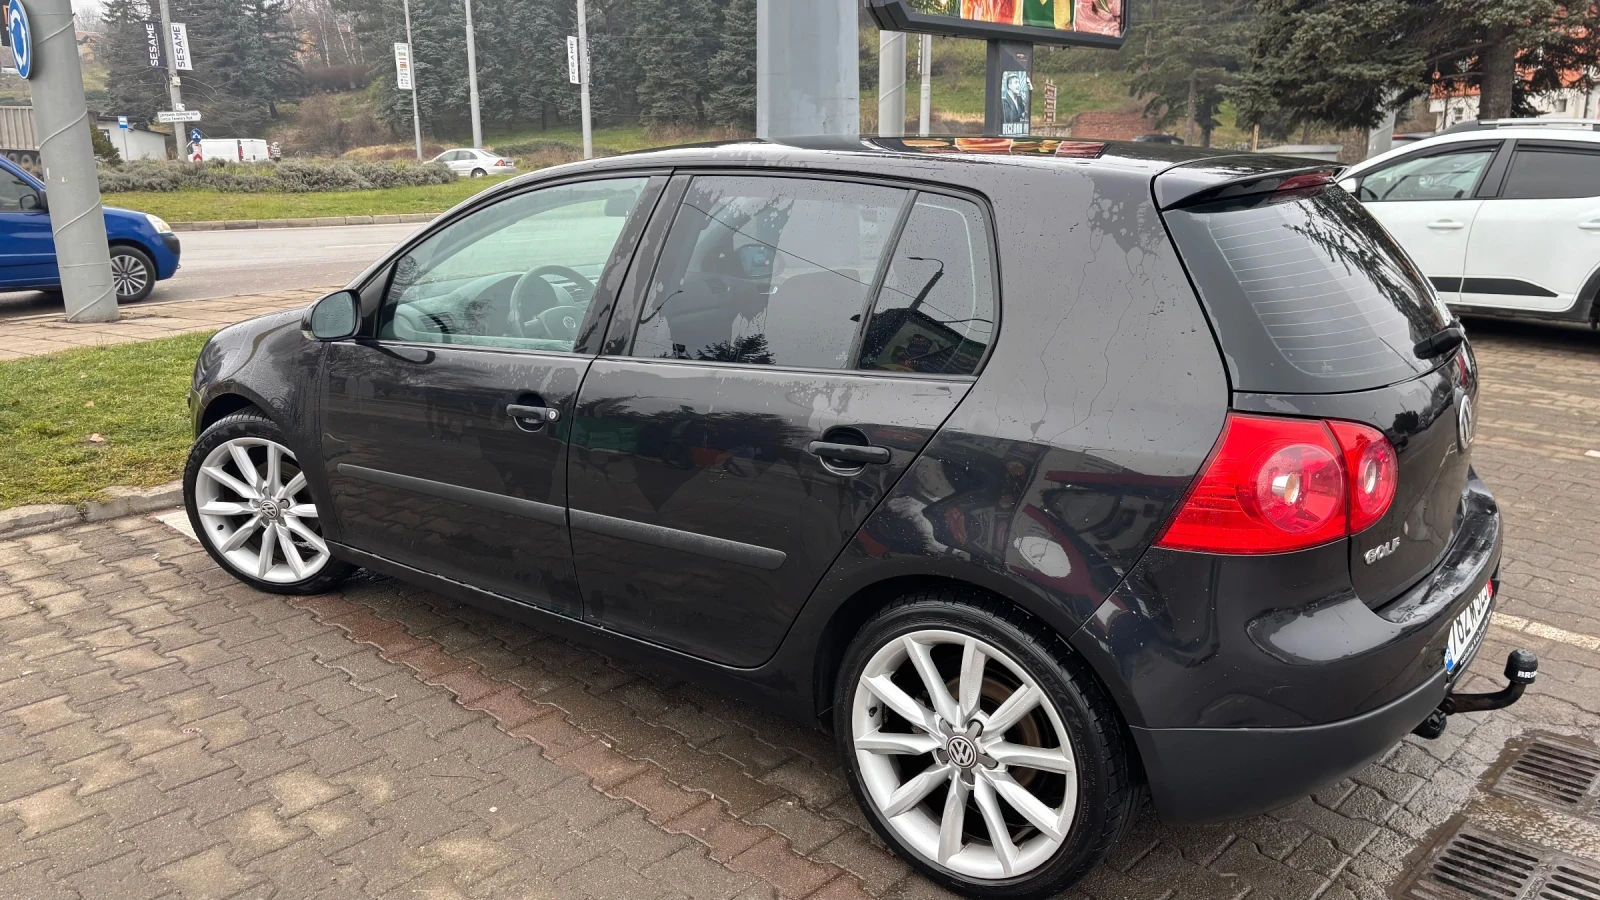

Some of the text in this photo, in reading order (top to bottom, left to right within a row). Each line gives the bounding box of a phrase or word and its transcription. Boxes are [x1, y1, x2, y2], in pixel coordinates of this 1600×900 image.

[145, 22, 159, 67] SESAME
[172, 25, 186, 68] SESAME
[1364, 536, 1400, 565] GOLF
